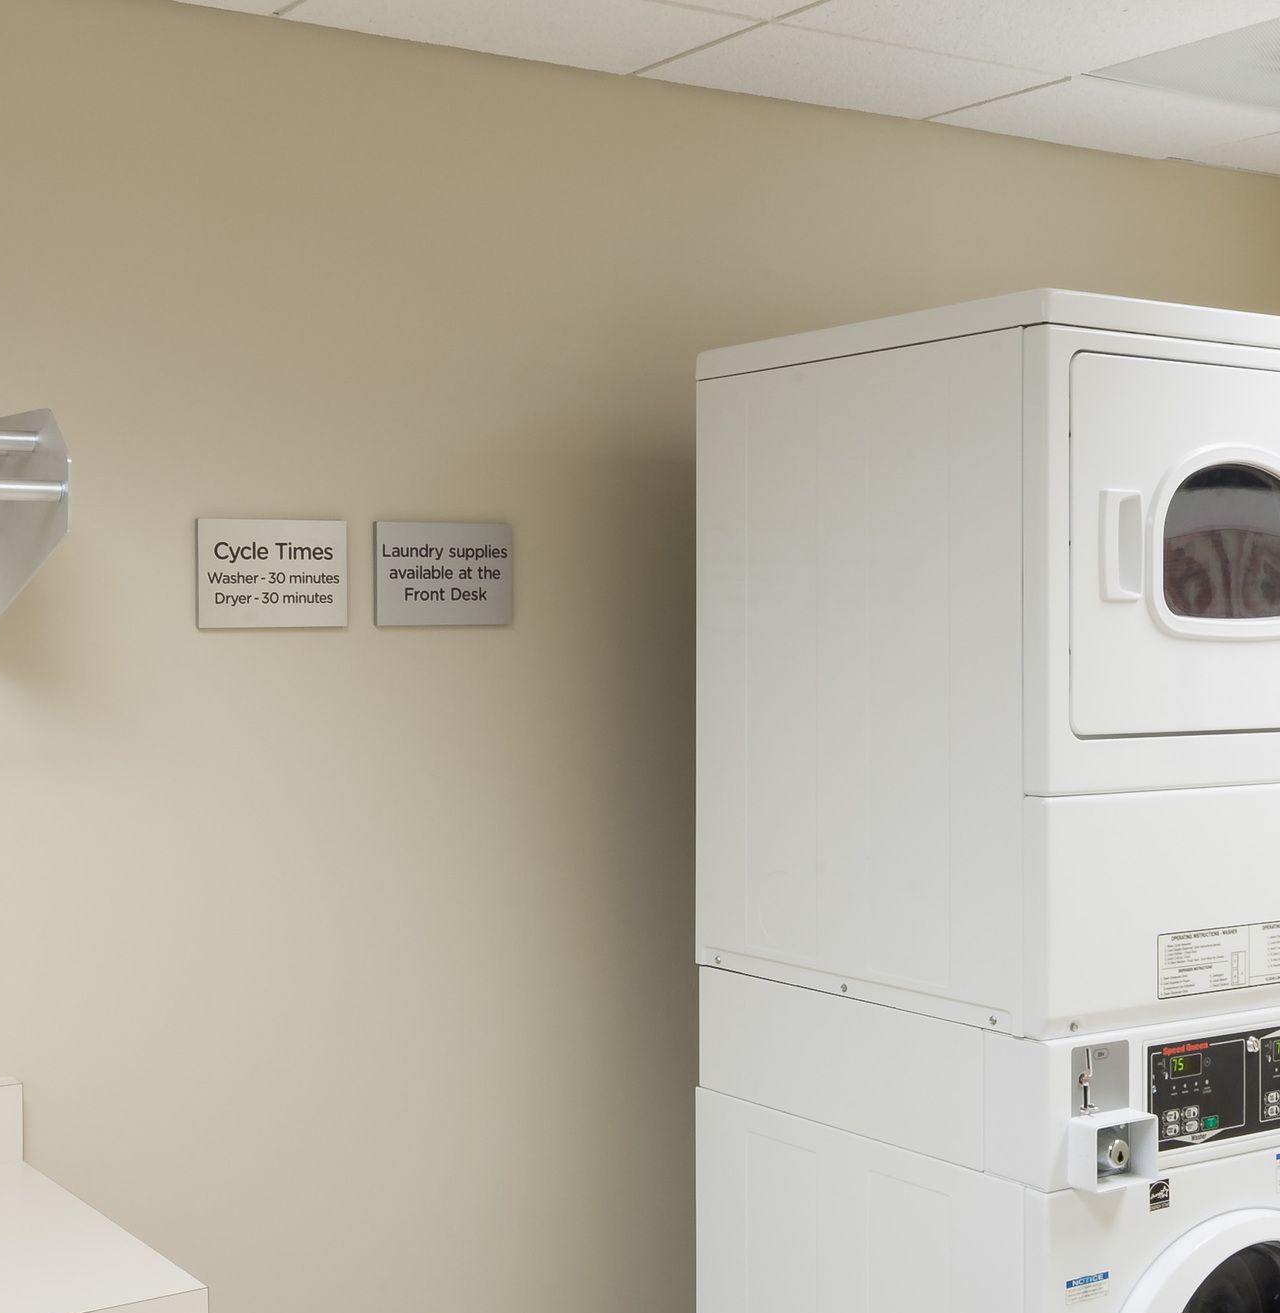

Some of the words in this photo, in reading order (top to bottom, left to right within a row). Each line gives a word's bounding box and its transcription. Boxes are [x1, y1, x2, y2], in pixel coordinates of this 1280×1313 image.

[213, 541, 269, 564] Cycle
[275, 541, 334, 560] Times
[382, 543, 444, 561] Laundry
[448, 544, 508, 561] supplies
[207, 571, 259, 584] Washer
[268, 571, 286, 584] 30
[289, 571, 340, 584] minutes
[389, 565, 454, 580] available
[458, 566, 473, 580] at
[477, 565, 501, 580] the
[215, 592, 252, 607] Dryer
[261, 591, 279, 604] 30
[282, 591, 334, 604] minutes
[404, 587, 446, 601] Front
[450, 586, 488, 601] Desk
[1162, 1045, 1185, 1056] Speed
[1172, 1057, 1184, 1071] 75
[1072, 1273, 1104, 1287] NOTICE
